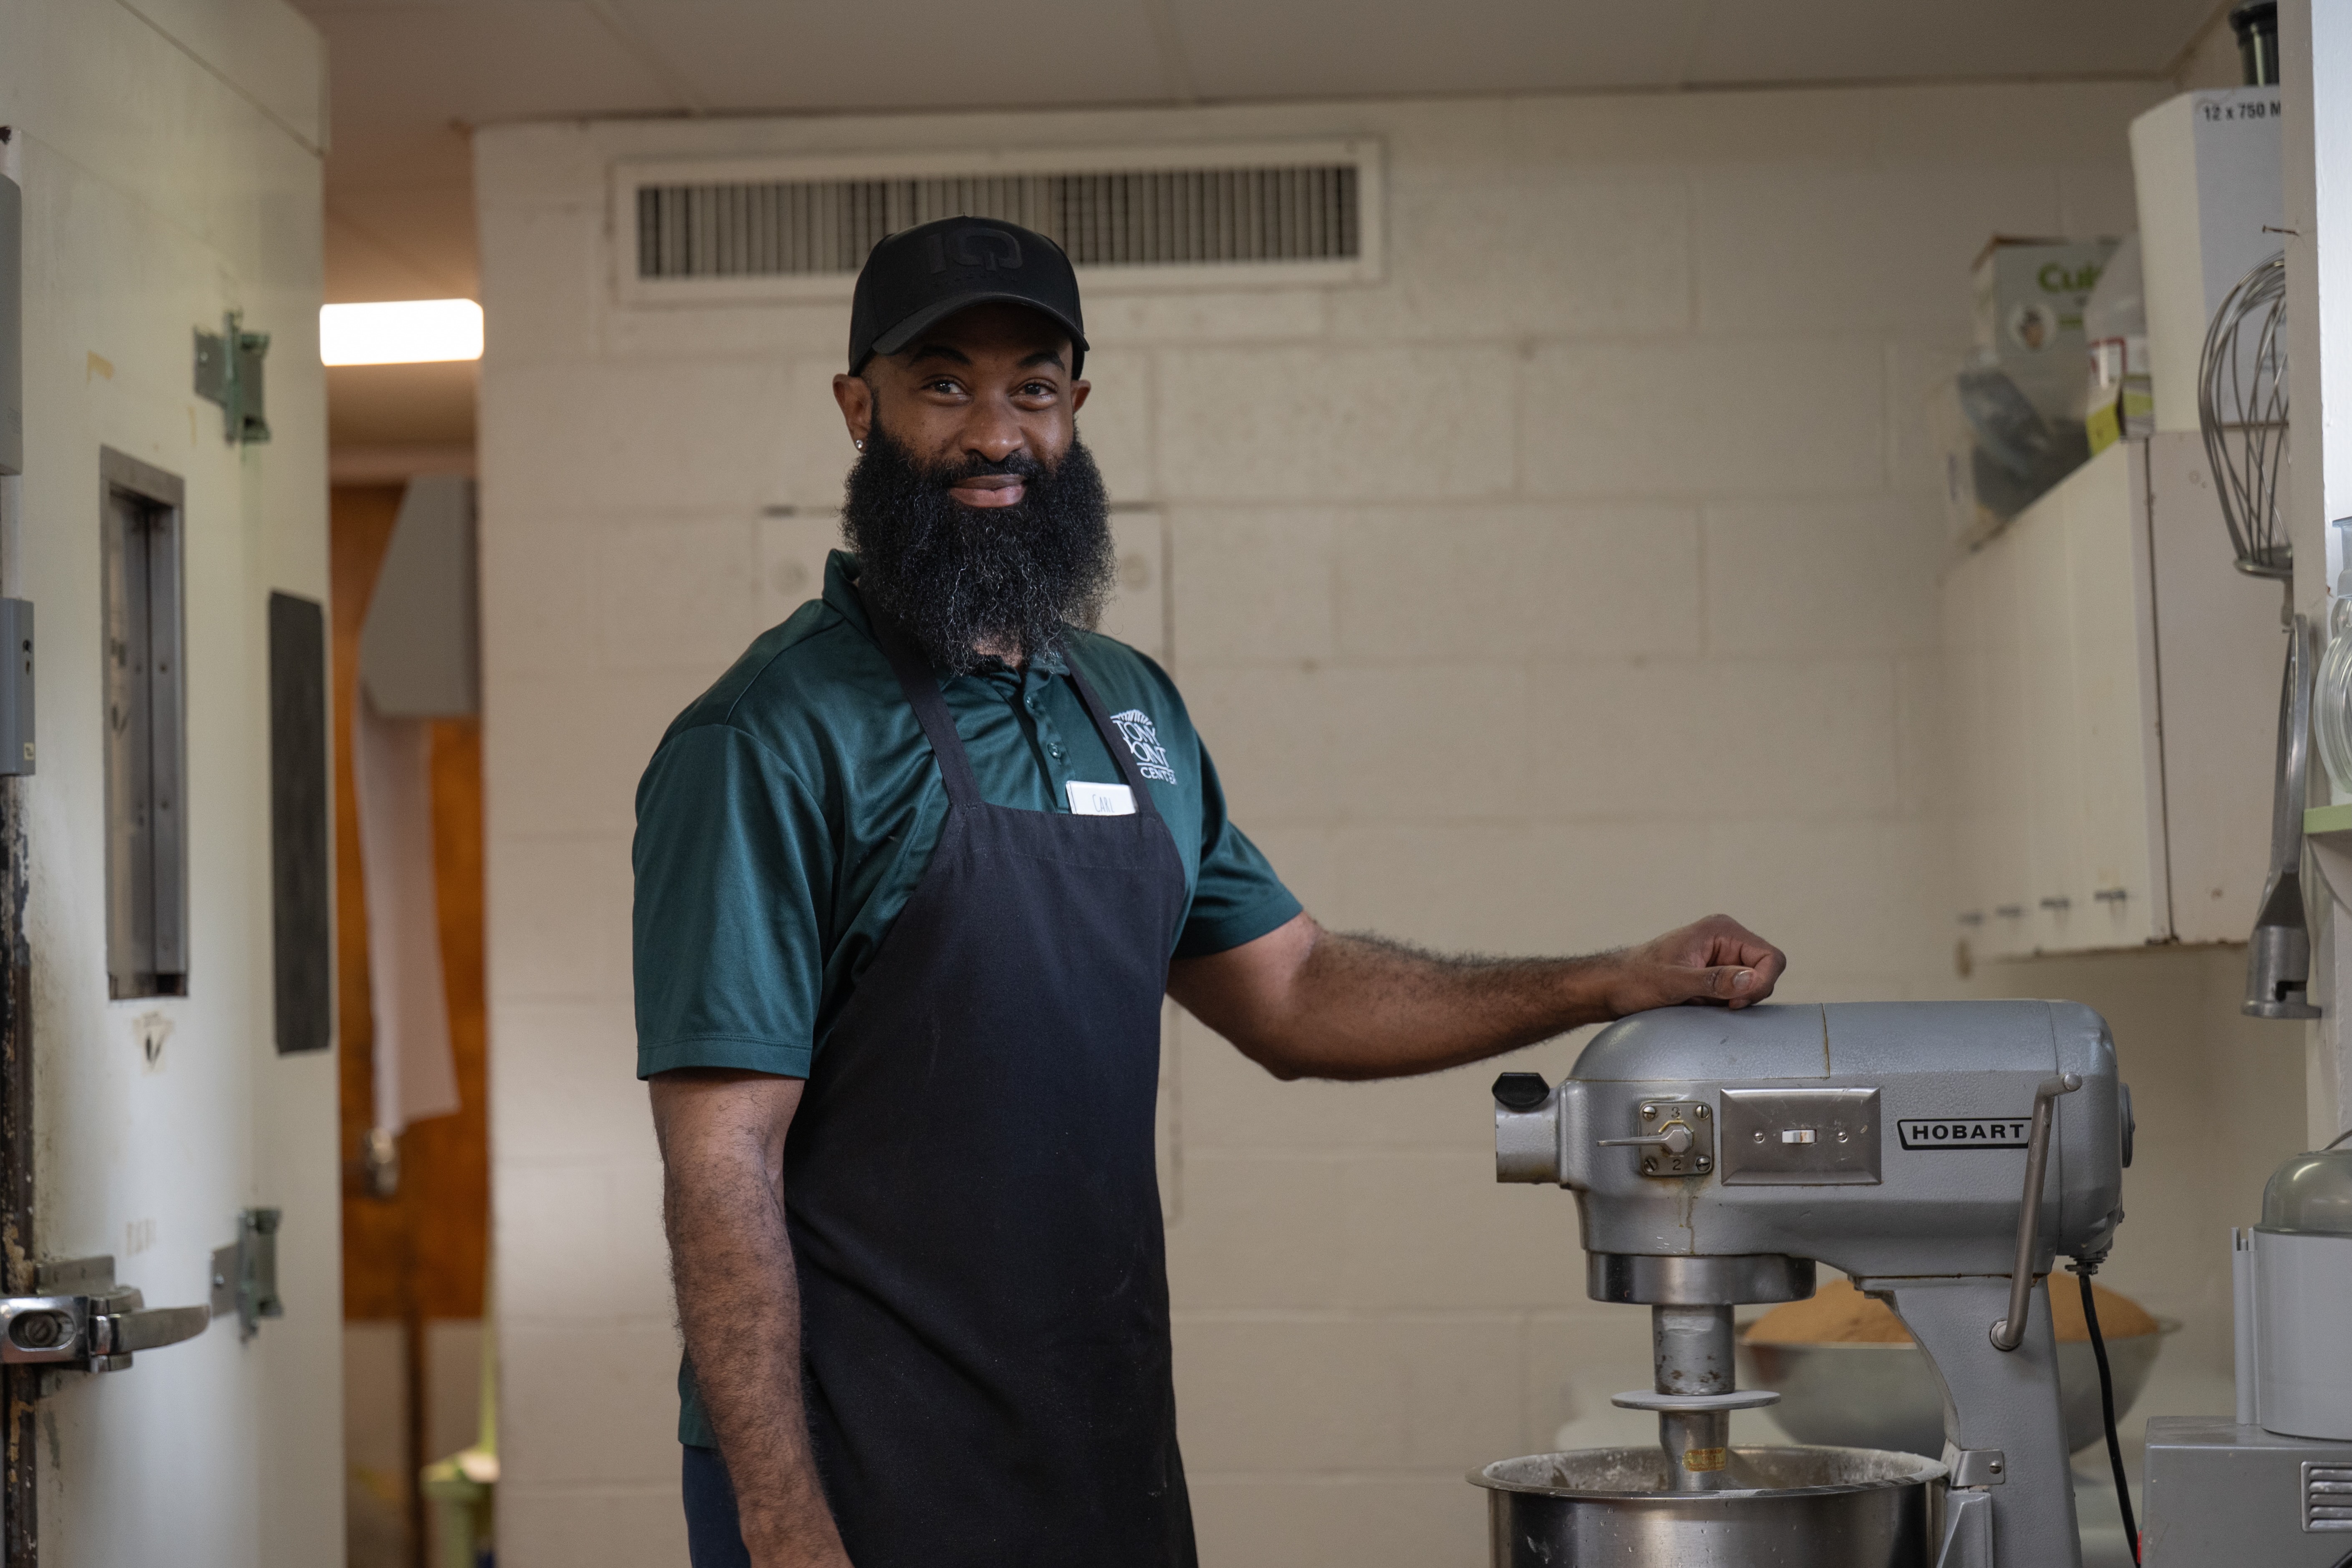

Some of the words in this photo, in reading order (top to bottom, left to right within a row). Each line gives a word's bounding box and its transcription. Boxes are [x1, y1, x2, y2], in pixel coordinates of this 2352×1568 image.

[2204, 104, 2220, 121] 12
[2226, 107, 2234, 120] x
[2237, 101, 2265, 118] 750
[1092, 794, 1115, 813] CARL
[1671, 1107, 1681, 1119] 3
[1912, 1124, 2024, 1139] HOBART
[1672, 1159, 1681, 1171] 2
